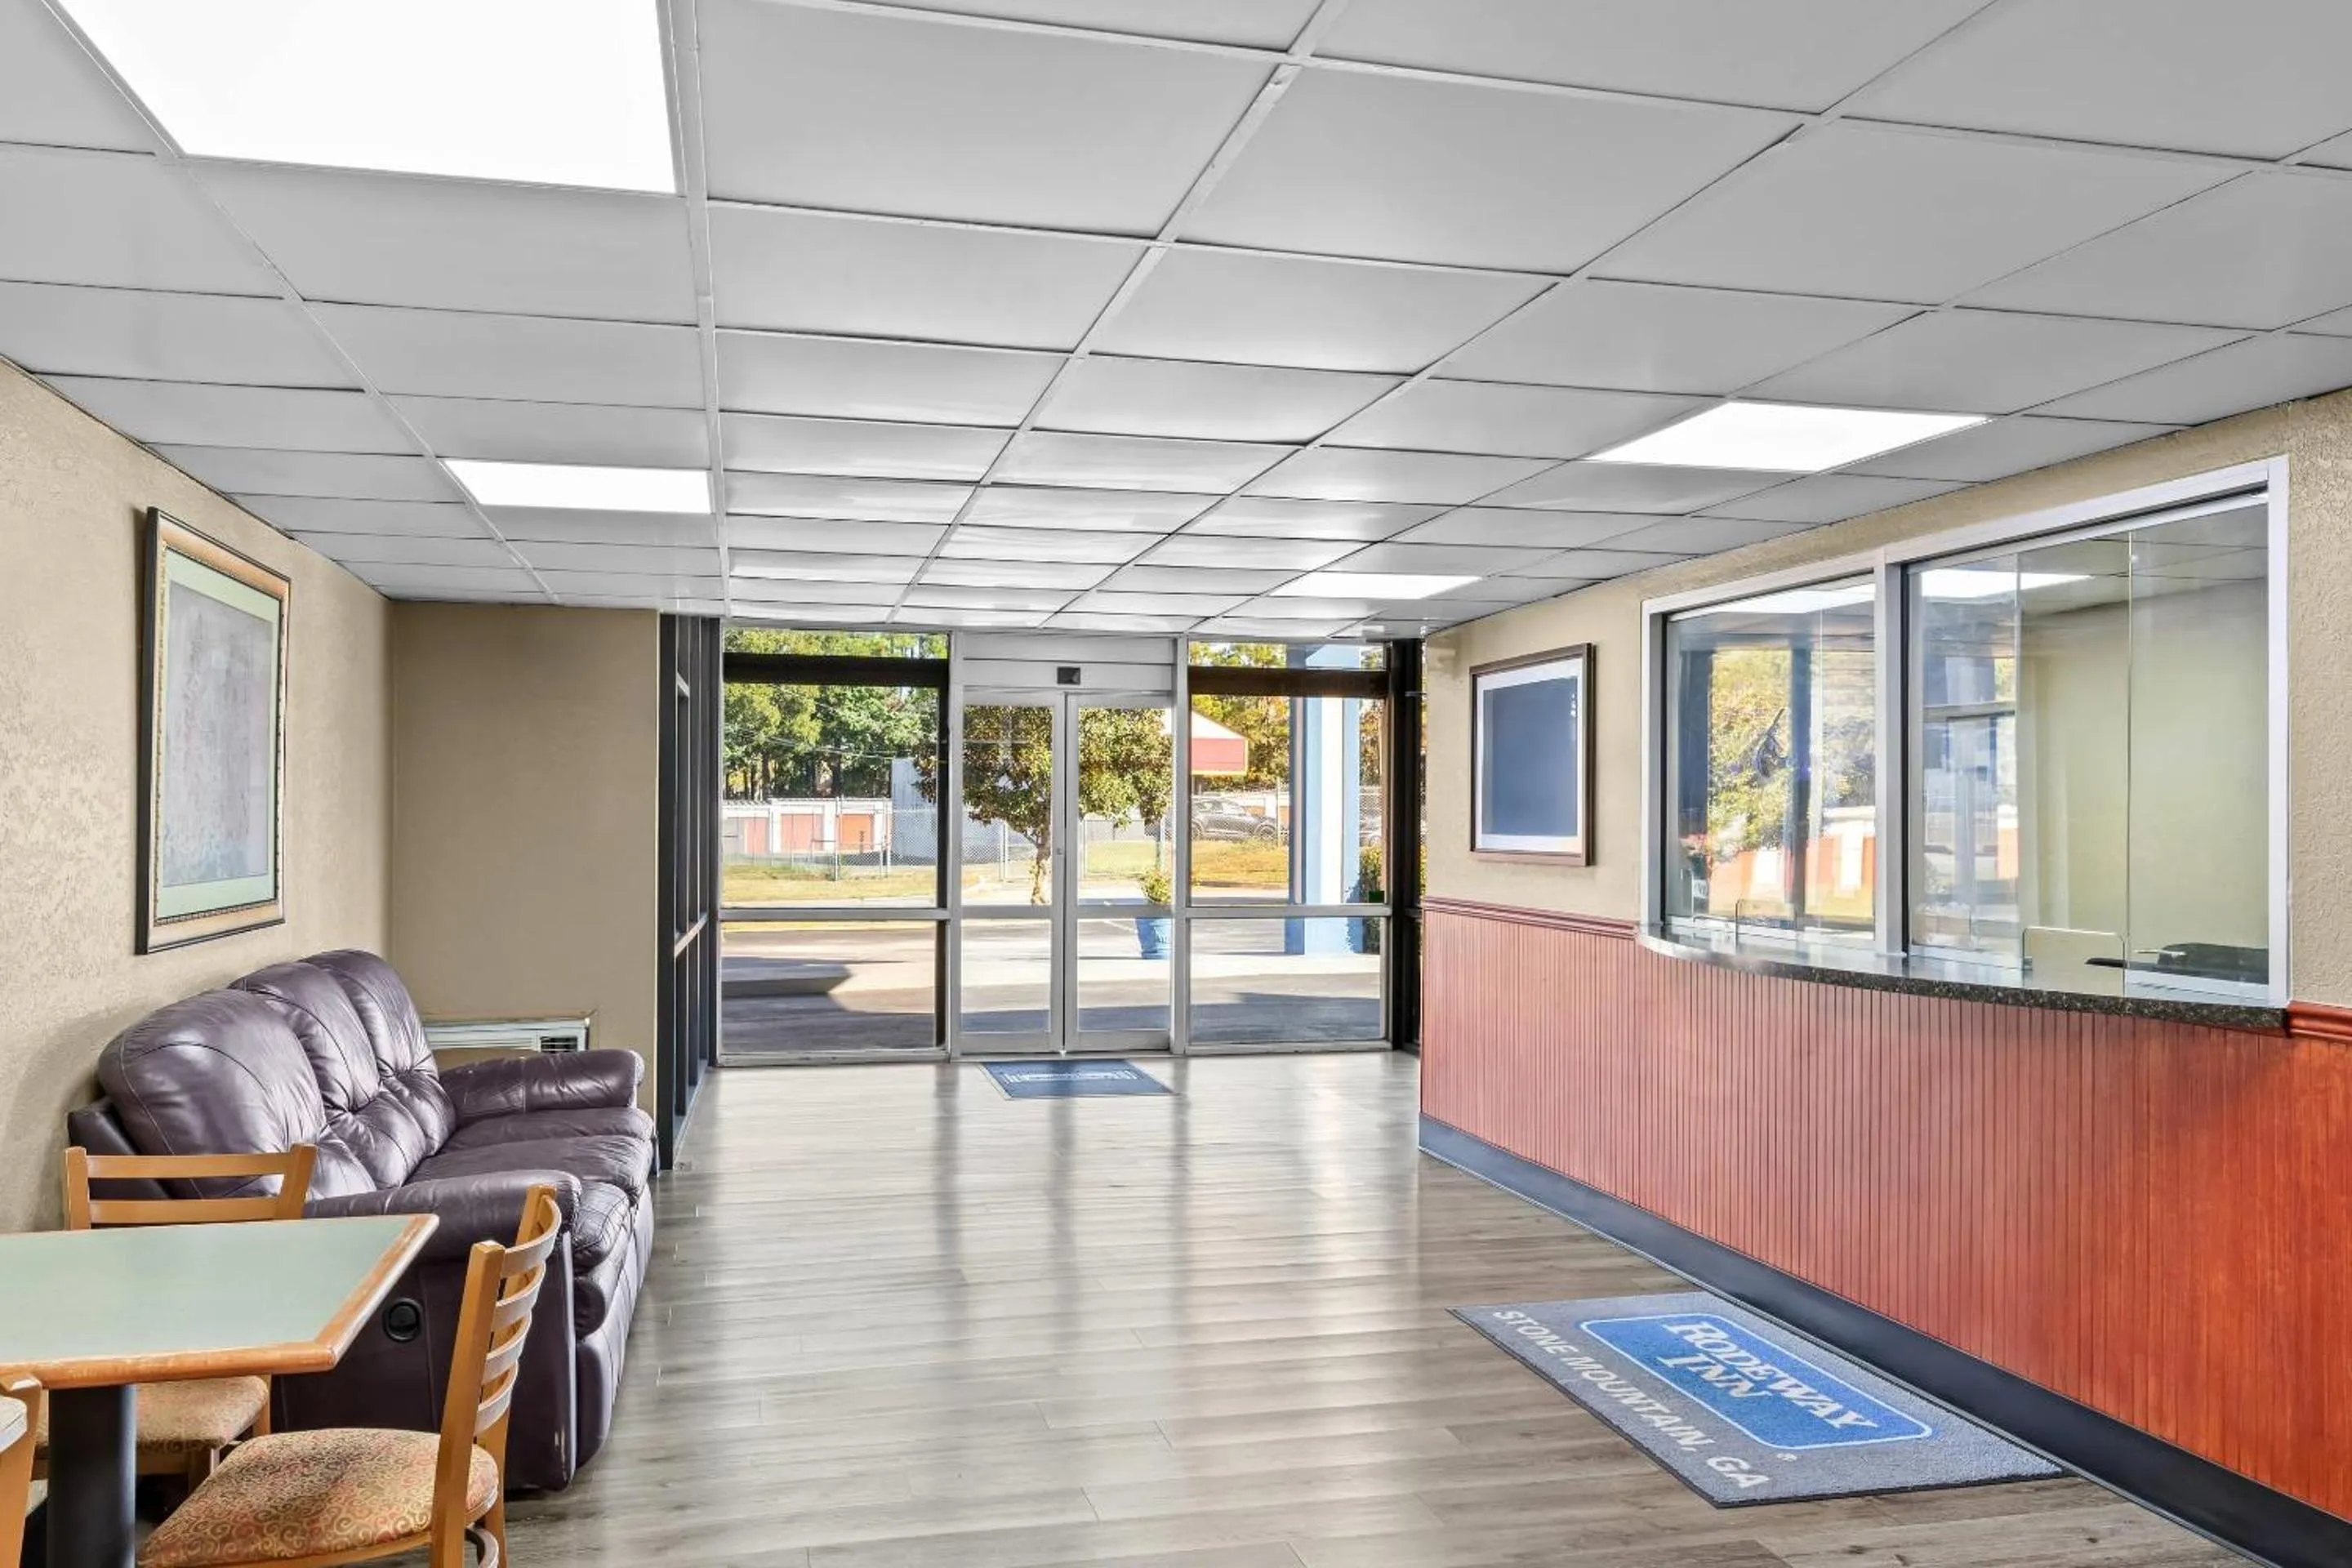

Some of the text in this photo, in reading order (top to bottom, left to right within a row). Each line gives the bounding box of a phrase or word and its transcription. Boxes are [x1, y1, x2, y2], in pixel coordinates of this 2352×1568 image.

[1492, 1310, 1771, 1489] STONE MOUNTAIN, GA
[1656, 1352, 1773, 1398] INN
[1661, 1321, 1878, 1428] RODEWAY
